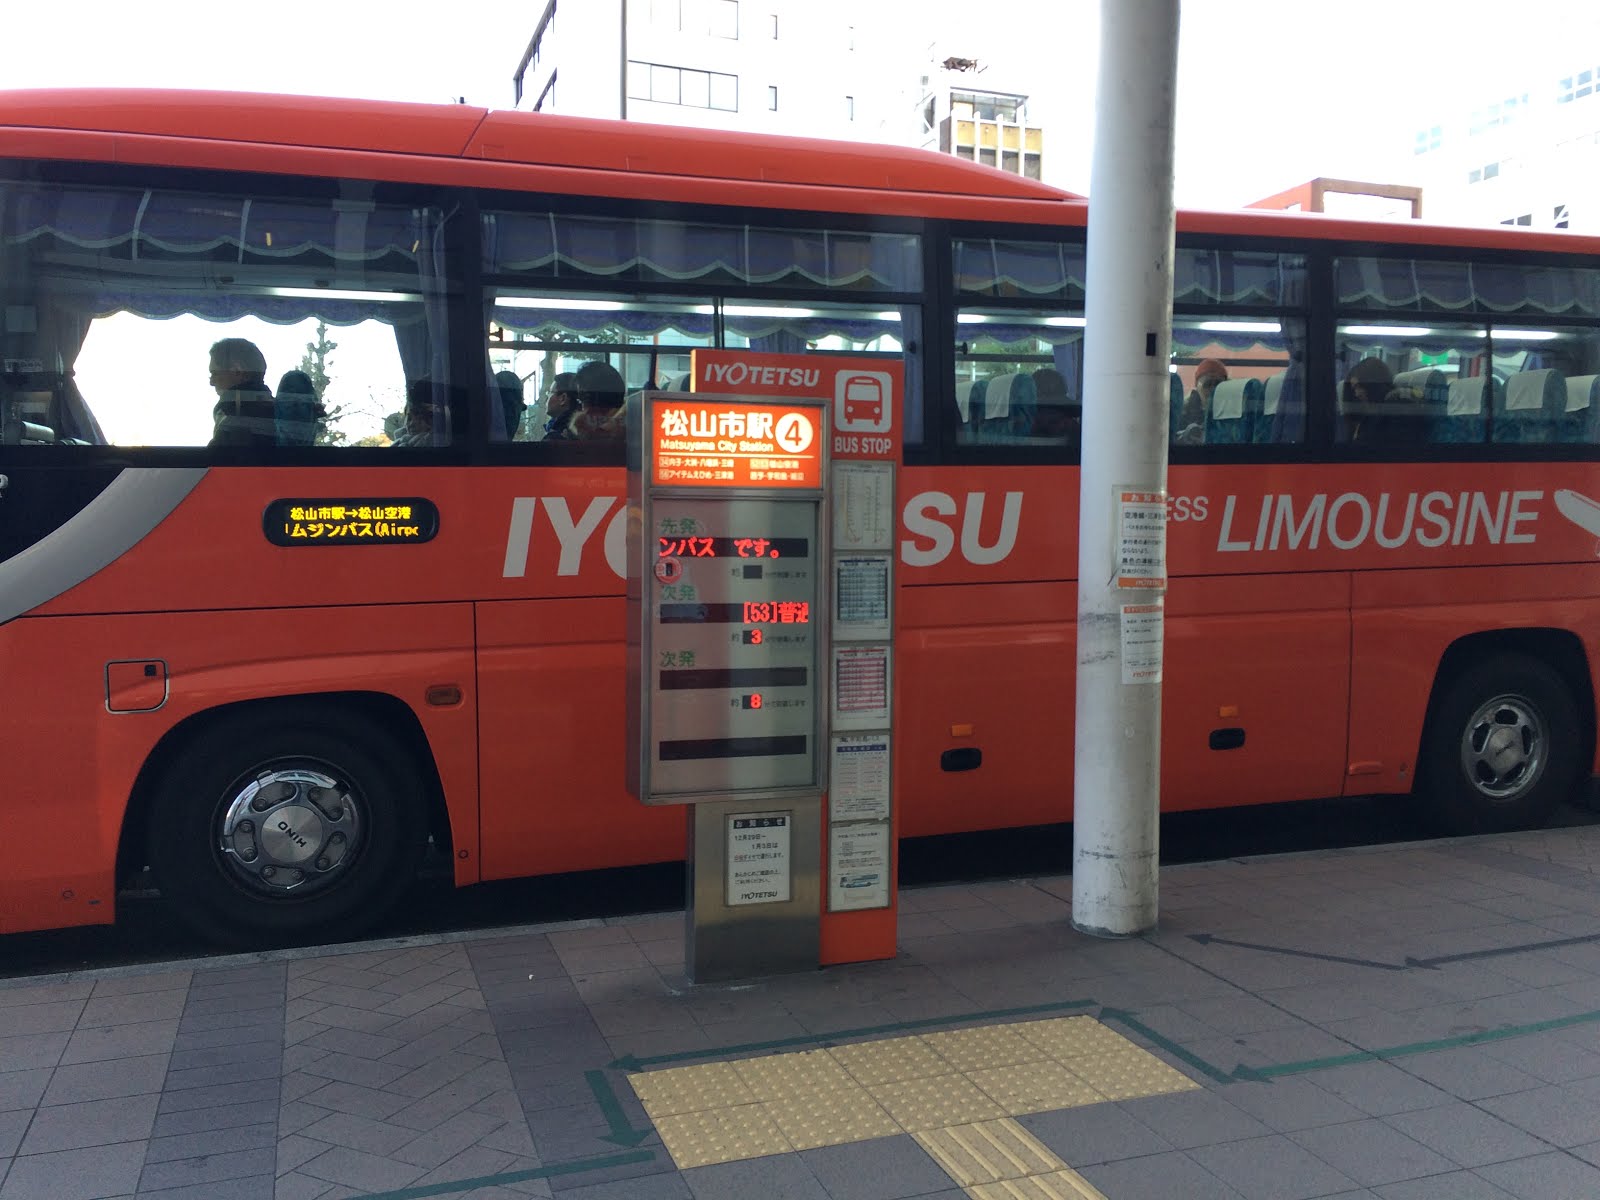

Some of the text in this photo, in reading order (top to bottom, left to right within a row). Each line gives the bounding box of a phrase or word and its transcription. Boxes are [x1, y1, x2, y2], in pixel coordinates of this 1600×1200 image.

[704, 362, 820, 387] IYOTETSU
[660, 408, 774, 439] 松山市駅
[660, 439, 774, 453] Matsuyama City Station
[835, 437, 892, 454] BUS STOP
[660, 517, 697, 534] 先発
[1216, 490, 1544, 552] LIMOUSINE
[751, 629, 763, 645] 3
[660, 651, 696, 667] 次発
[750, 693, 762, 710] 8
[277, 821, 308, 848] HINO
[741, 890, 778, 900] IYOTETSU
